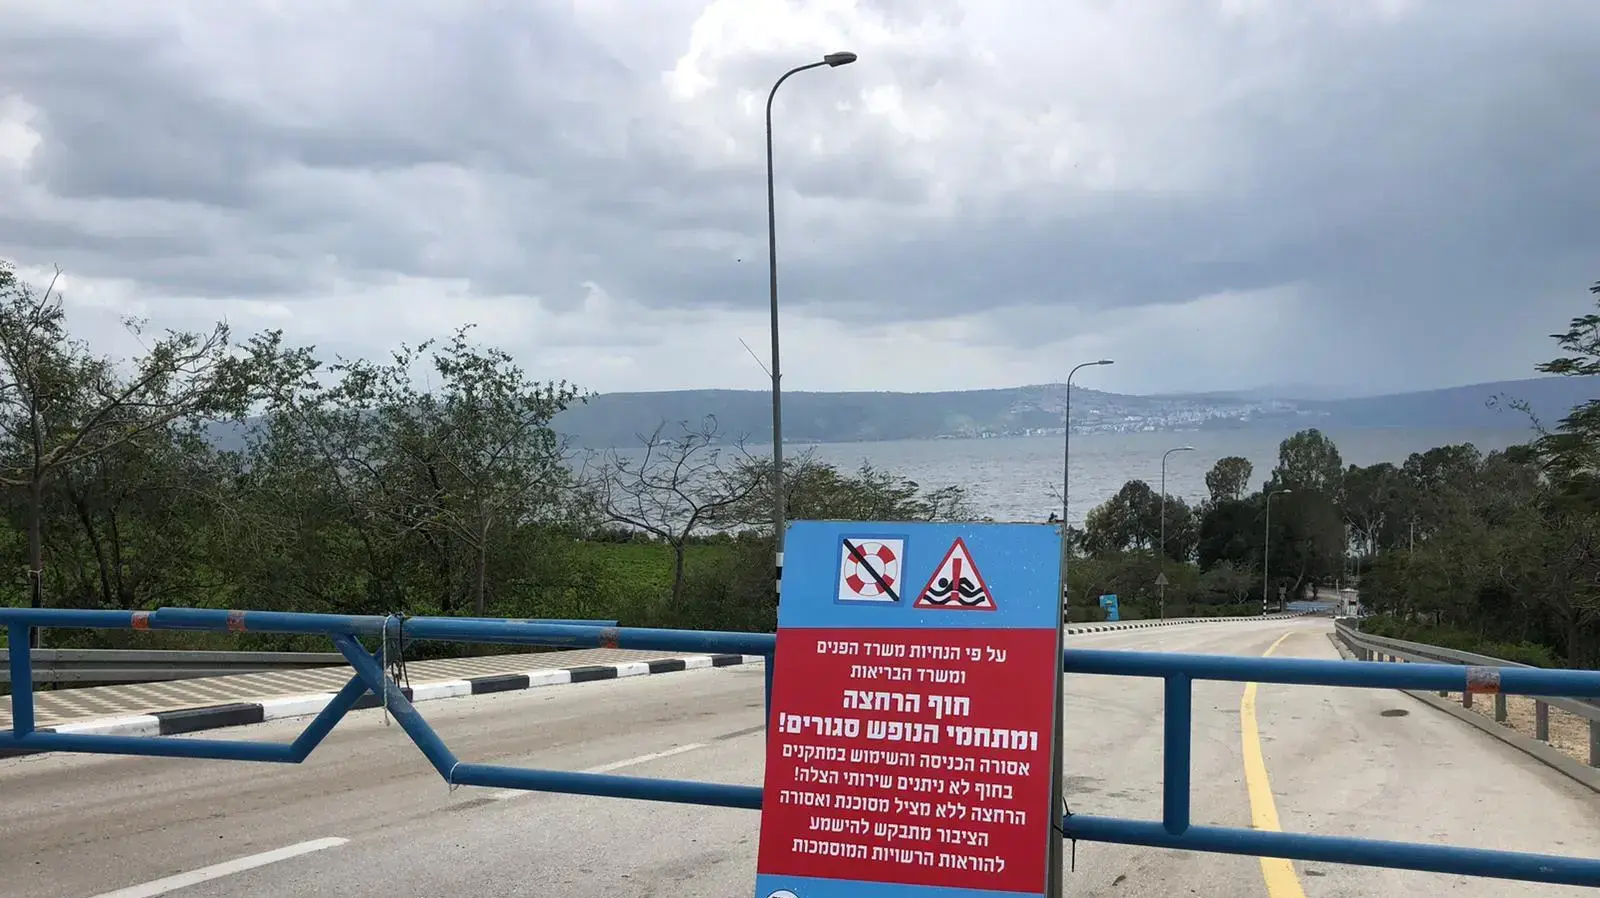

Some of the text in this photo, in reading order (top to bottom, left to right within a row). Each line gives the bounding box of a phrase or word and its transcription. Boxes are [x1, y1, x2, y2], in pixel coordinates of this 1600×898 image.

[817, 641, 1006, 662] על פי הנחיות משרד הפנים
[851, 665, 965, 683] ומשרד הבריאות
[844, 690, 969, 719] חוף הרחצה
[779, 713, 1037, 750] ומתחמי הנופש סגורים!
[783, 744, 1029, 775] אסורה הכניסה והשימוש במתקנים
[795, 767, 1012, 800] בחוף לא ניתנים שירותי הצלה!
[780, 791, 1025, 825] הרחצה ללא מציל מסוכנת ואסורה
[810, 817, 988, 846] הציבור מתבקש להישמע
[792, 839, 1004, 872] להוראות הרשויות המוסמכות
